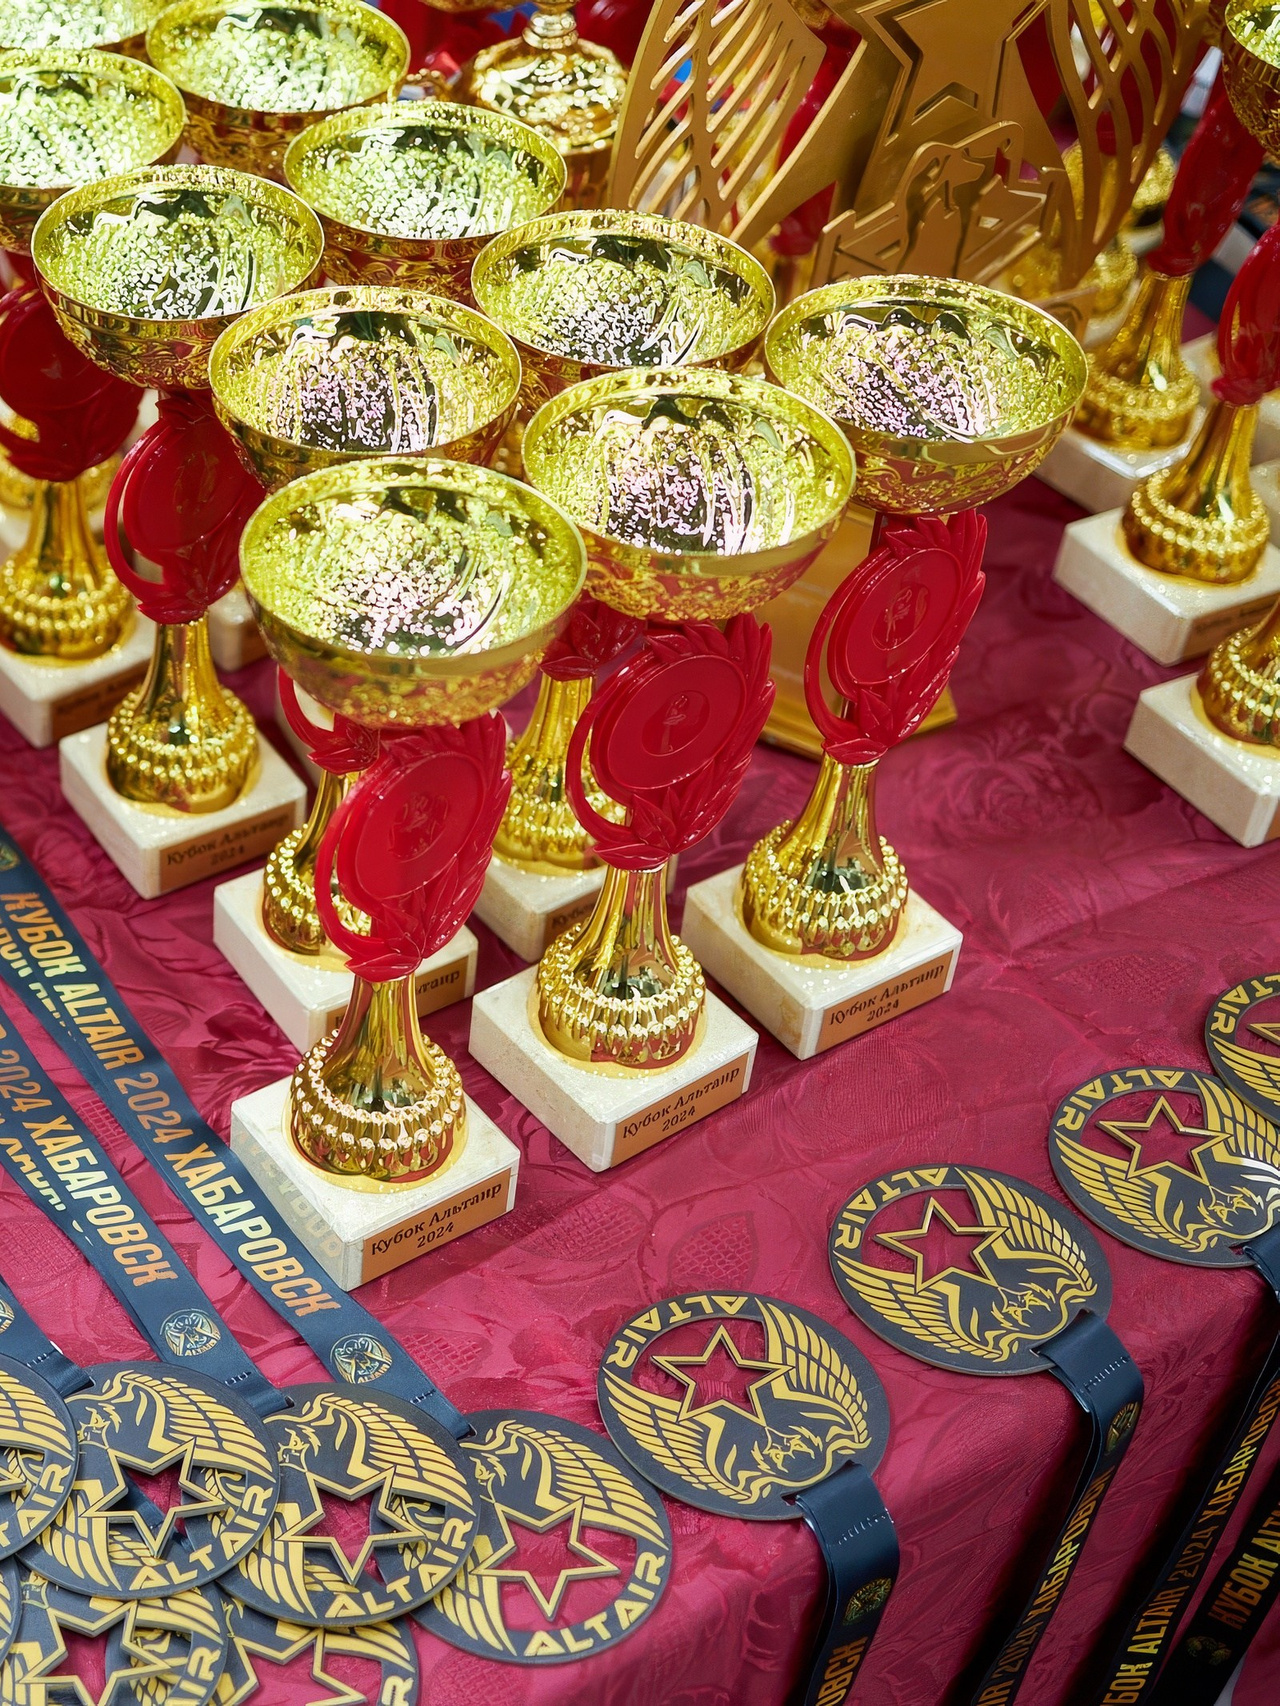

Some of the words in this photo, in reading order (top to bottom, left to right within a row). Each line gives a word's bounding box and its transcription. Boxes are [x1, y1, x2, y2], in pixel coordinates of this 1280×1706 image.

[829, 997, 878, 1027] Кубок
[882, 965, 945, 1001] Альтаир
[866, 999, 901, 1022] 2024
[0, 891, 87, 978] КУБОК
[53, 983, 145, 1071] ALTAIR
[115, 1070, 194, 1144] 2024
[164, 1142, 342, 1316] ХАБАРОВСК
[623, 1106, 670, 1139] Кубок
[673, 1067, 740, 1108] Альтаир
[663, 1108, 697, 1132] 2024
[1056, 1067, 1186, 1133] ALTAIR
[22, 1114, 178, 1286] ХАБАРОВСК
[371, 1219, 425, 1255] Кубок
[428, 1183, 503, 1227] Альтаир
[417, 1223, 455, 1249] 2024
[834, 1166, 949, 1251] ALTAIR
[606, 1294, 748, 1369] ALTAIR
[129, 1483, 274, 1592] ALTAIR
[325, 1515, 475, 1618] ALTAIR
[523, 1551, 668, 1657] ALTAIR
[1127, 1586, 1190, 1654] ALTAIR
[1207, 1553, 1278, 1630] КУБОК
